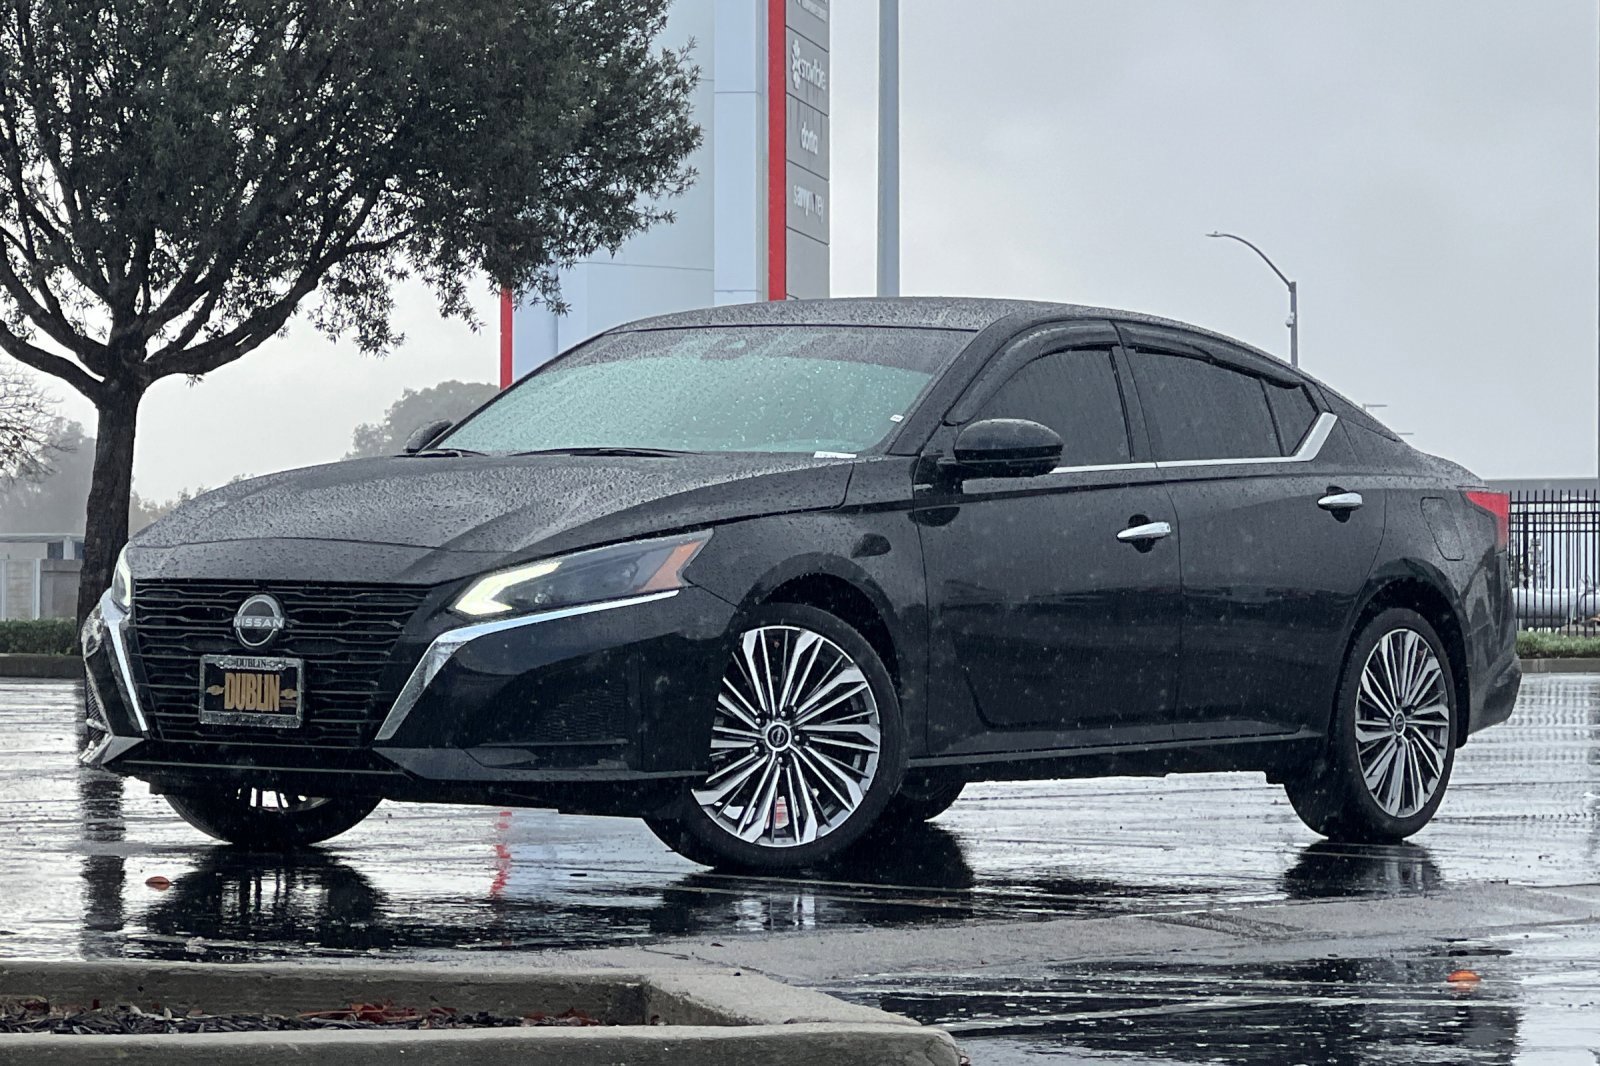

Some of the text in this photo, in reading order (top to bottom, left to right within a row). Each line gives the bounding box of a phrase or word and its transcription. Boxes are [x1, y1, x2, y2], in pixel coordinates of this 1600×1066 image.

[233, 617, 284, 628] NISSAN
[236, 658, 267, 668] DUBLIN
[224, 672, 280, 711] DUBLIN
